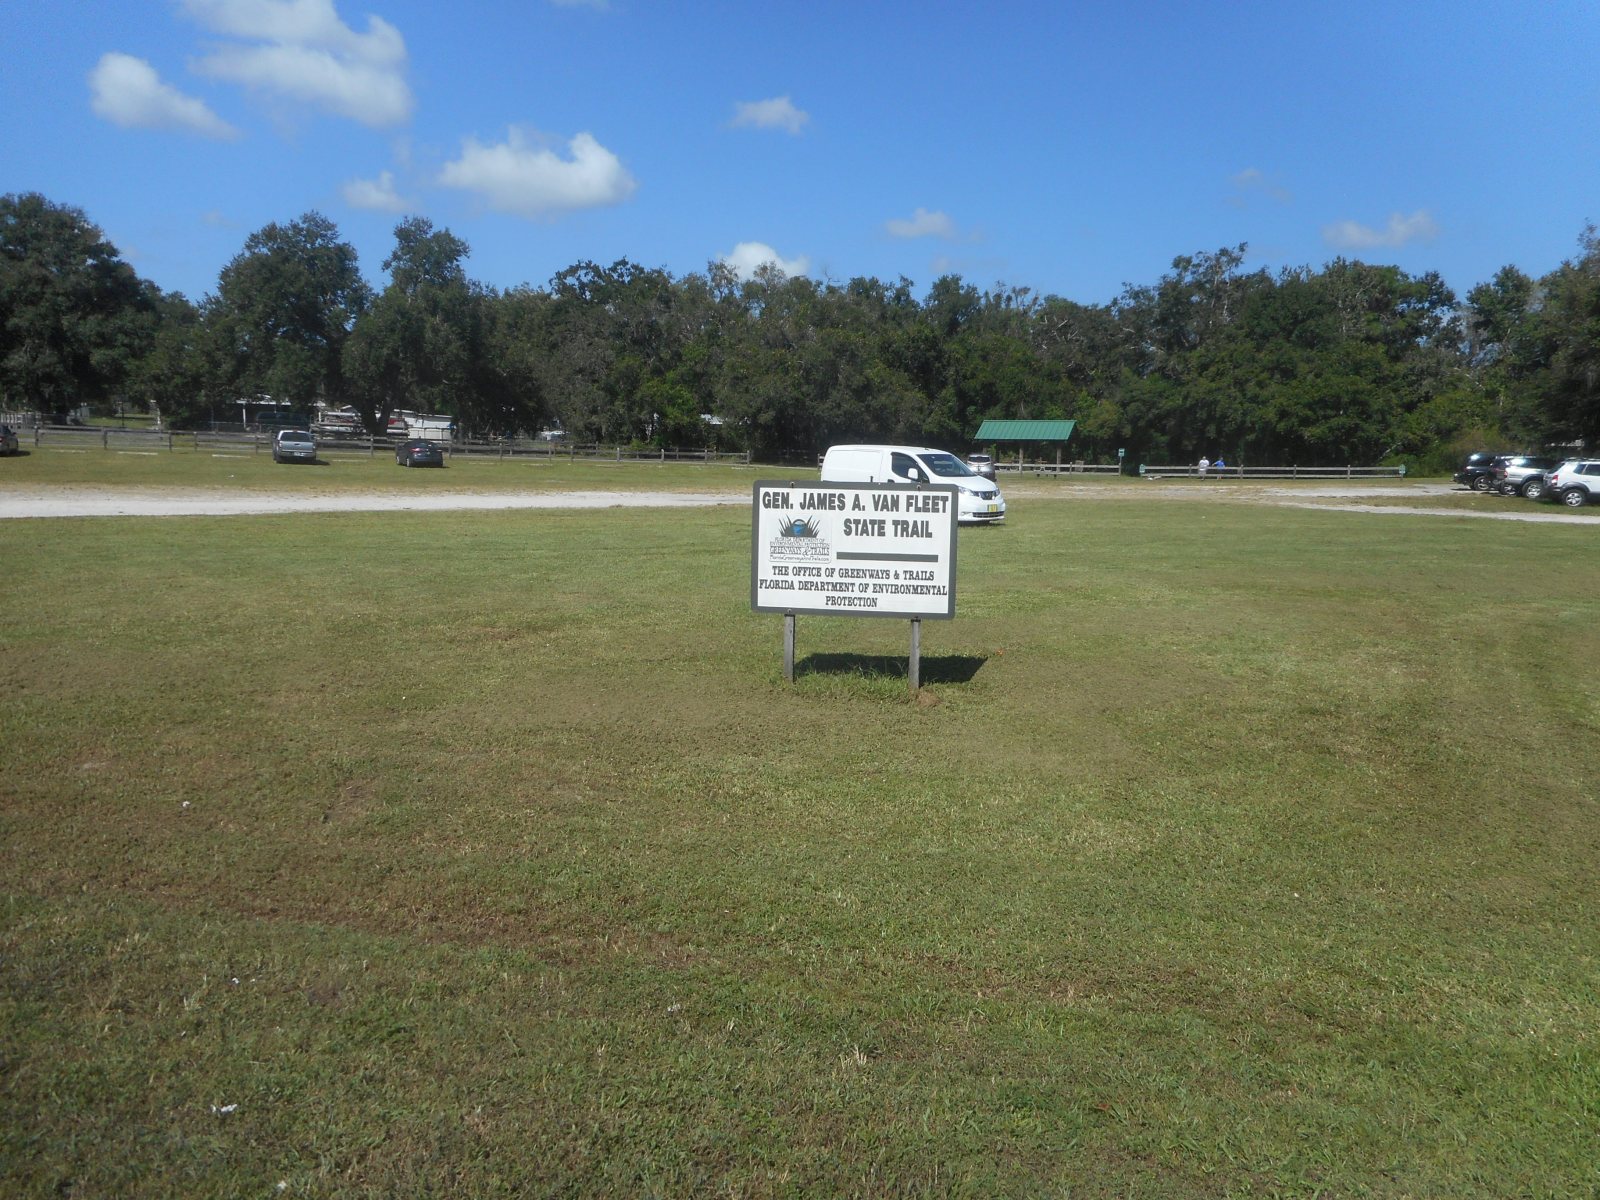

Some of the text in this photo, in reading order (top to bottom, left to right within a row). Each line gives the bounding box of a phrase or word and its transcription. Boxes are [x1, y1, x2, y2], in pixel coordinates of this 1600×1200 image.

[762, 491, 949, 514] GEN. JAMES A. VAN FLEET
[843, 518, 933, 539] STATE TRAIL
[769, 545, 830, 557] GREENWAYS & TRAILS
[772, 565, 935, 581] THE OFFICE OF GREENWAYS & TRAILS
[759, 579, 947, 596] FLORIDA DEPARTMENT OF ENVIRONMENTAL
[825, 595, 878, 607] PROTECTION
